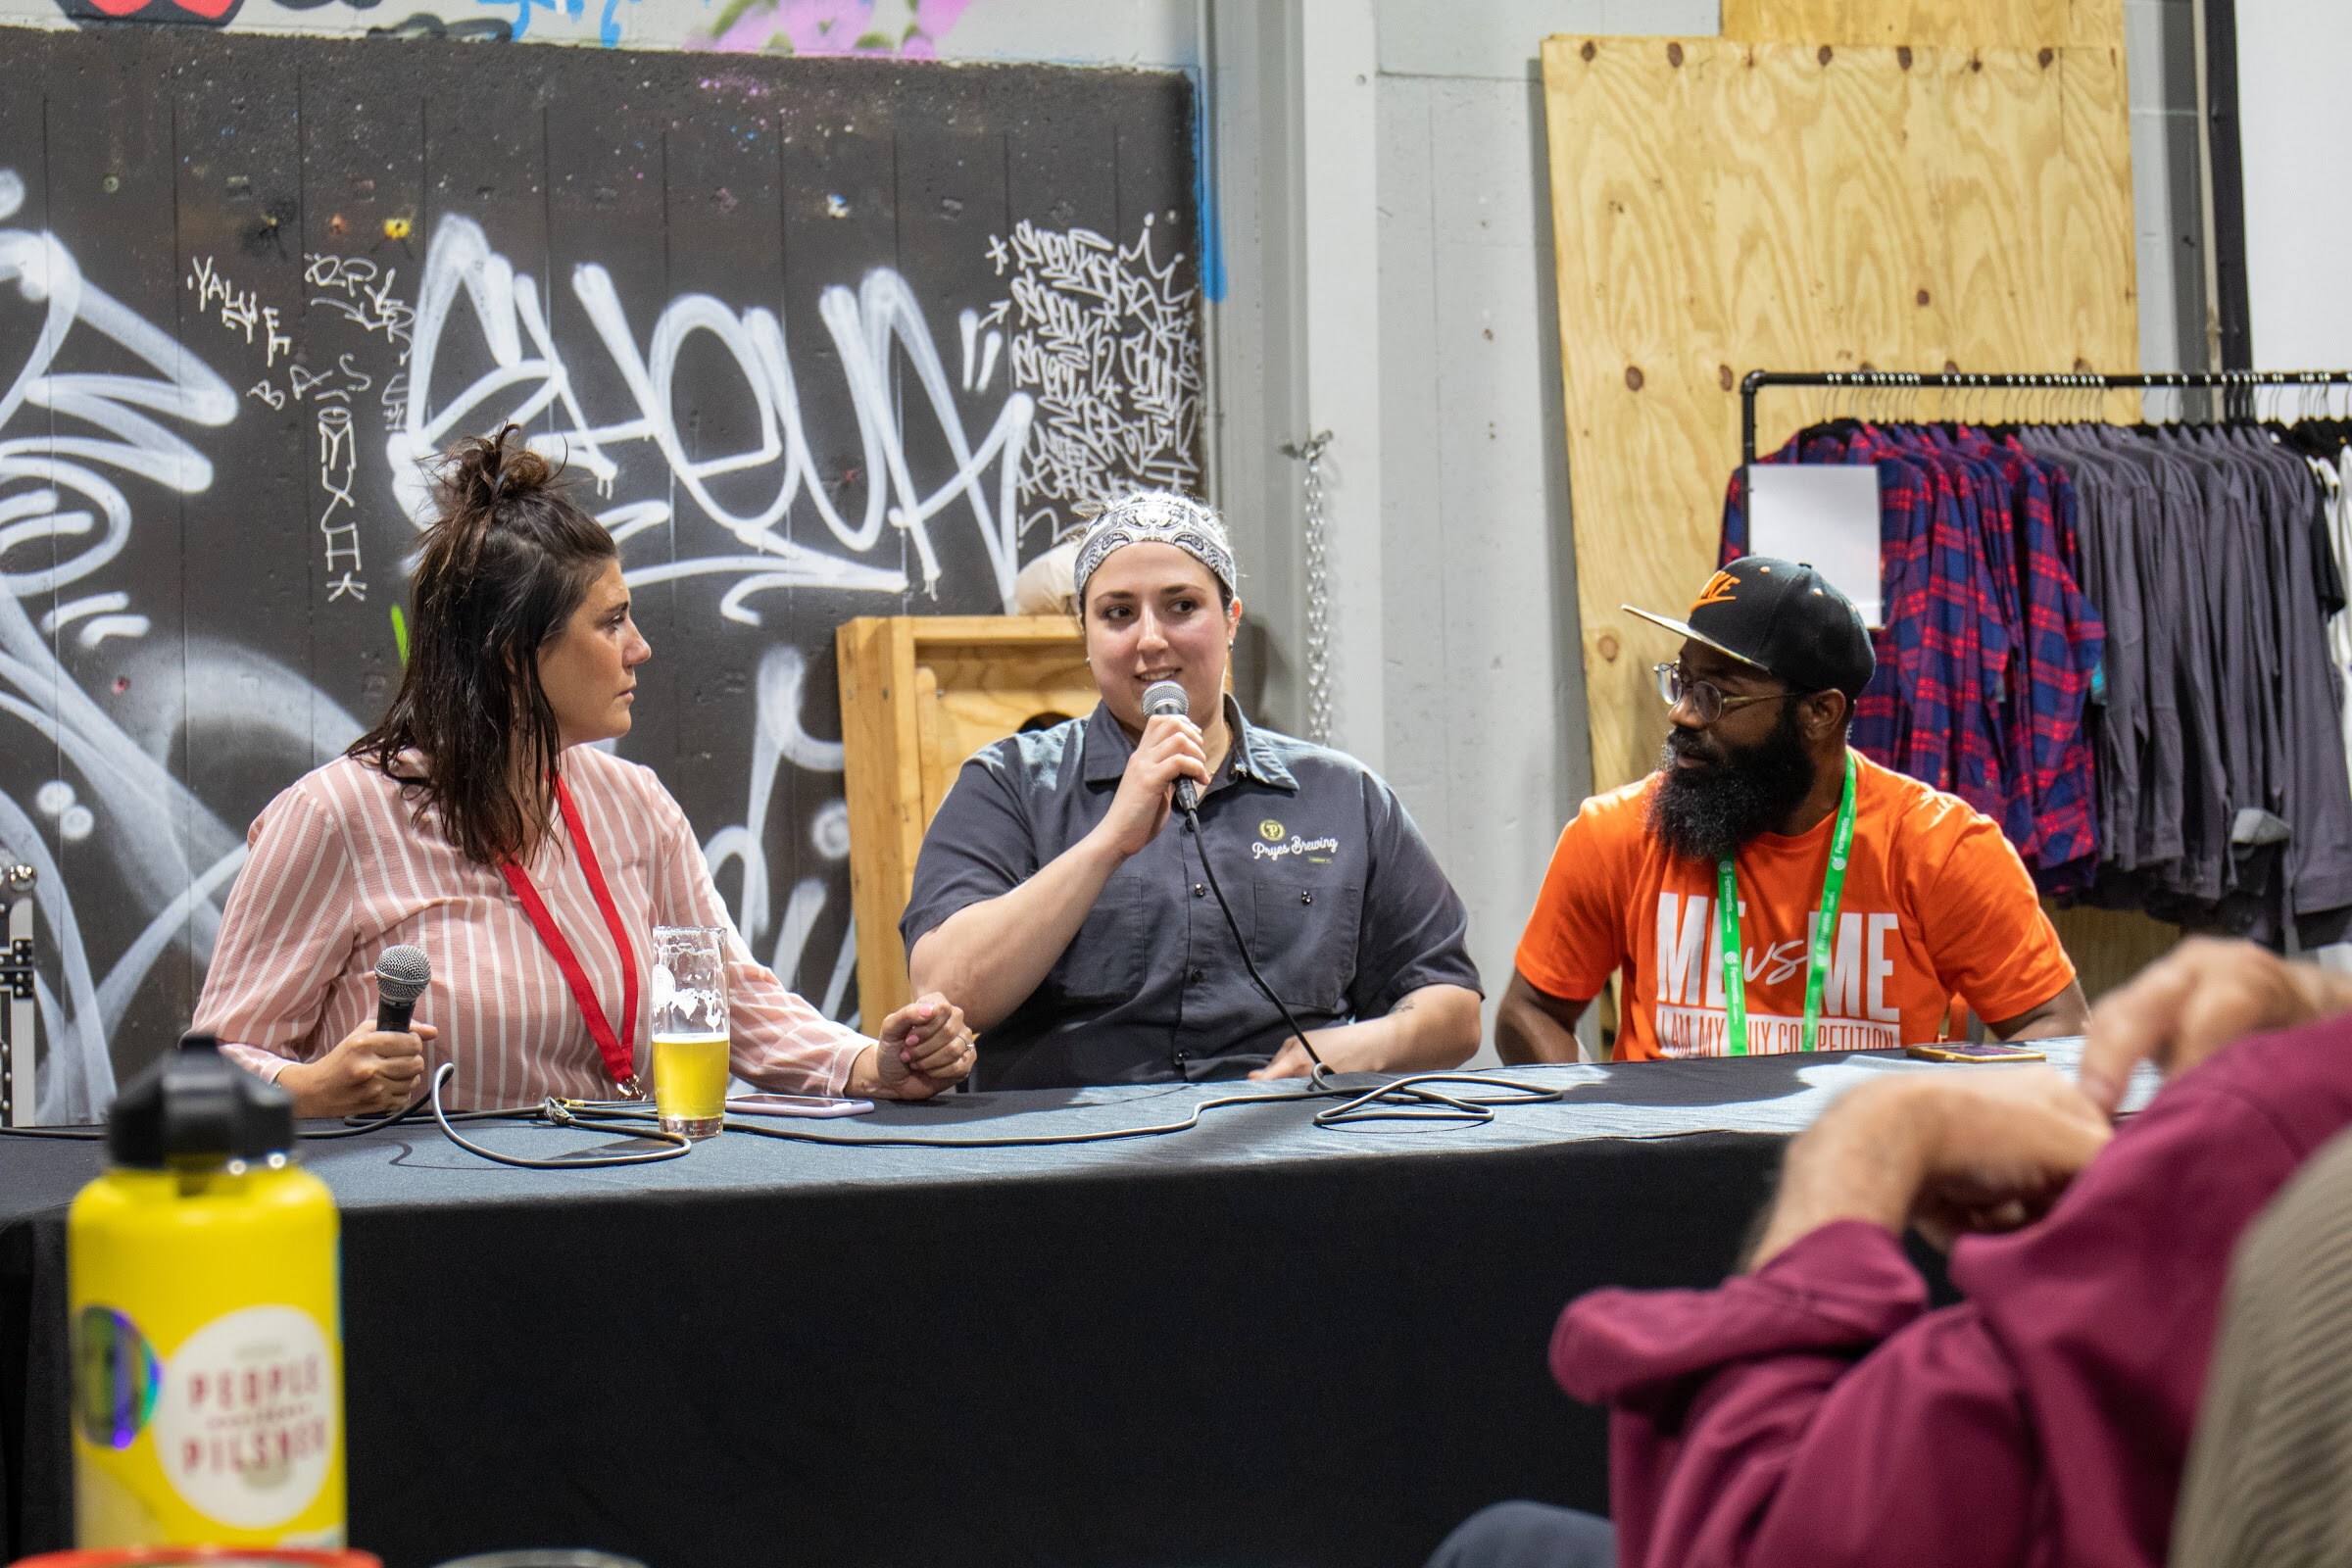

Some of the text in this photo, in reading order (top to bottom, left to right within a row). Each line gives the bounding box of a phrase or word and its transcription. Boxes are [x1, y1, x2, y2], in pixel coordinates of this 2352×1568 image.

[1251, 835, 1338, 860] Pryes Brewing
[1808, 911, 1899, 1022] ME
[1699, 1016, 1725, 1056] MY
